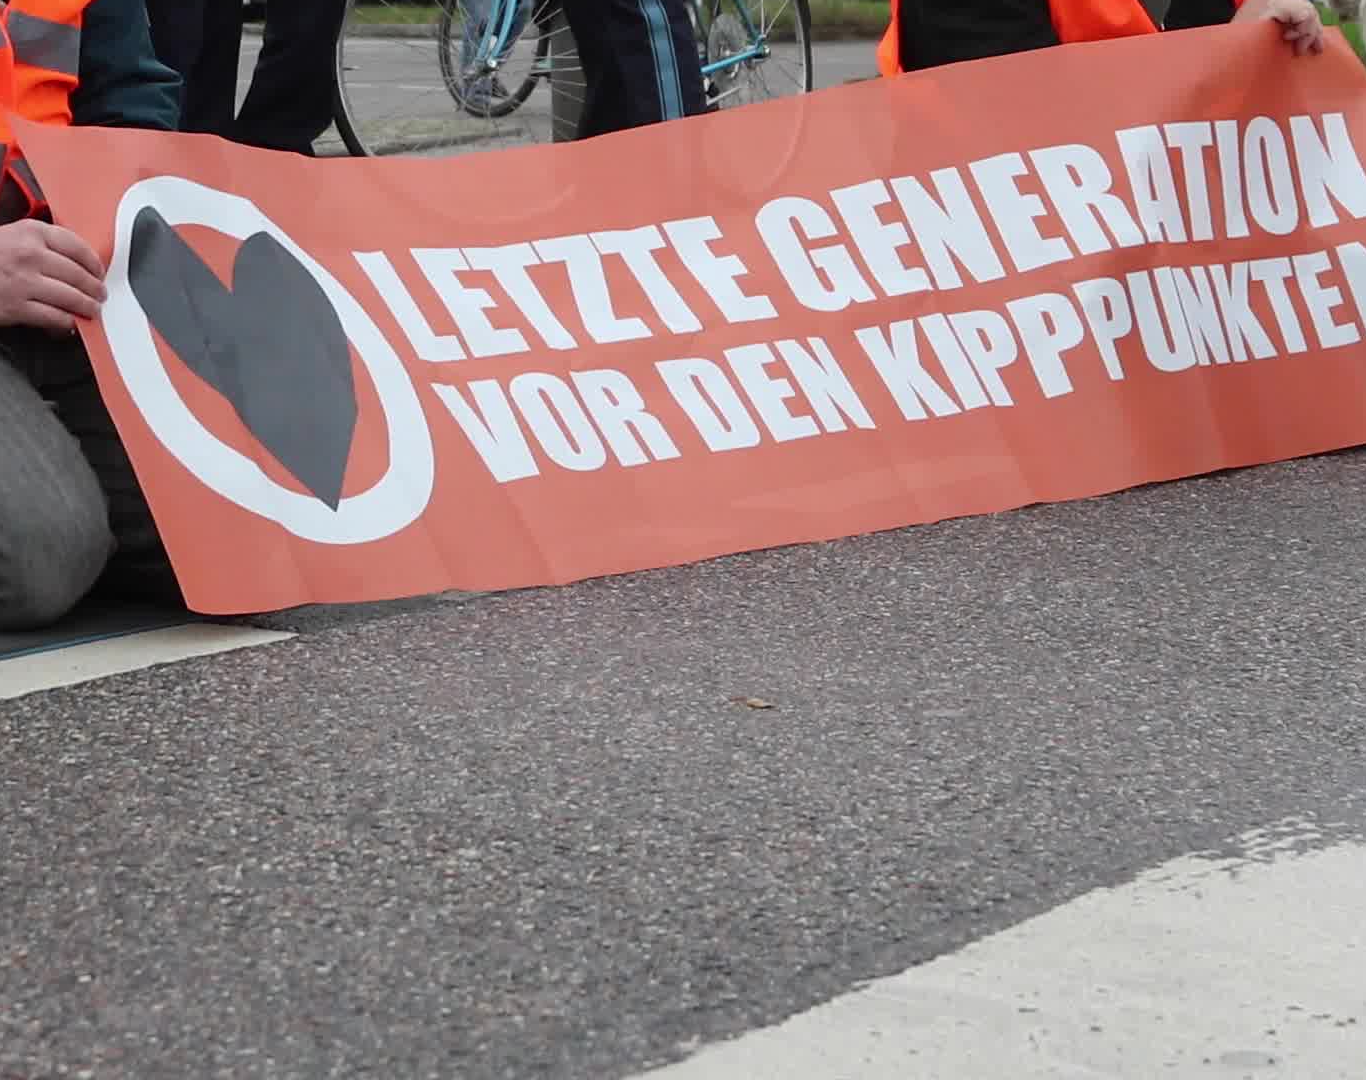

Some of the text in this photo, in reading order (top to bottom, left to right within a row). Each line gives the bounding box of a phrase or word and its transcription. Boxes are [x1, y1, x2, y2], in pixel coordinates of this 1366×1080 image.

[352, 216, 779, 362] LETZTE
[430, 370, 682, 483] VOR
[654, 336, 877, 452] DEN
